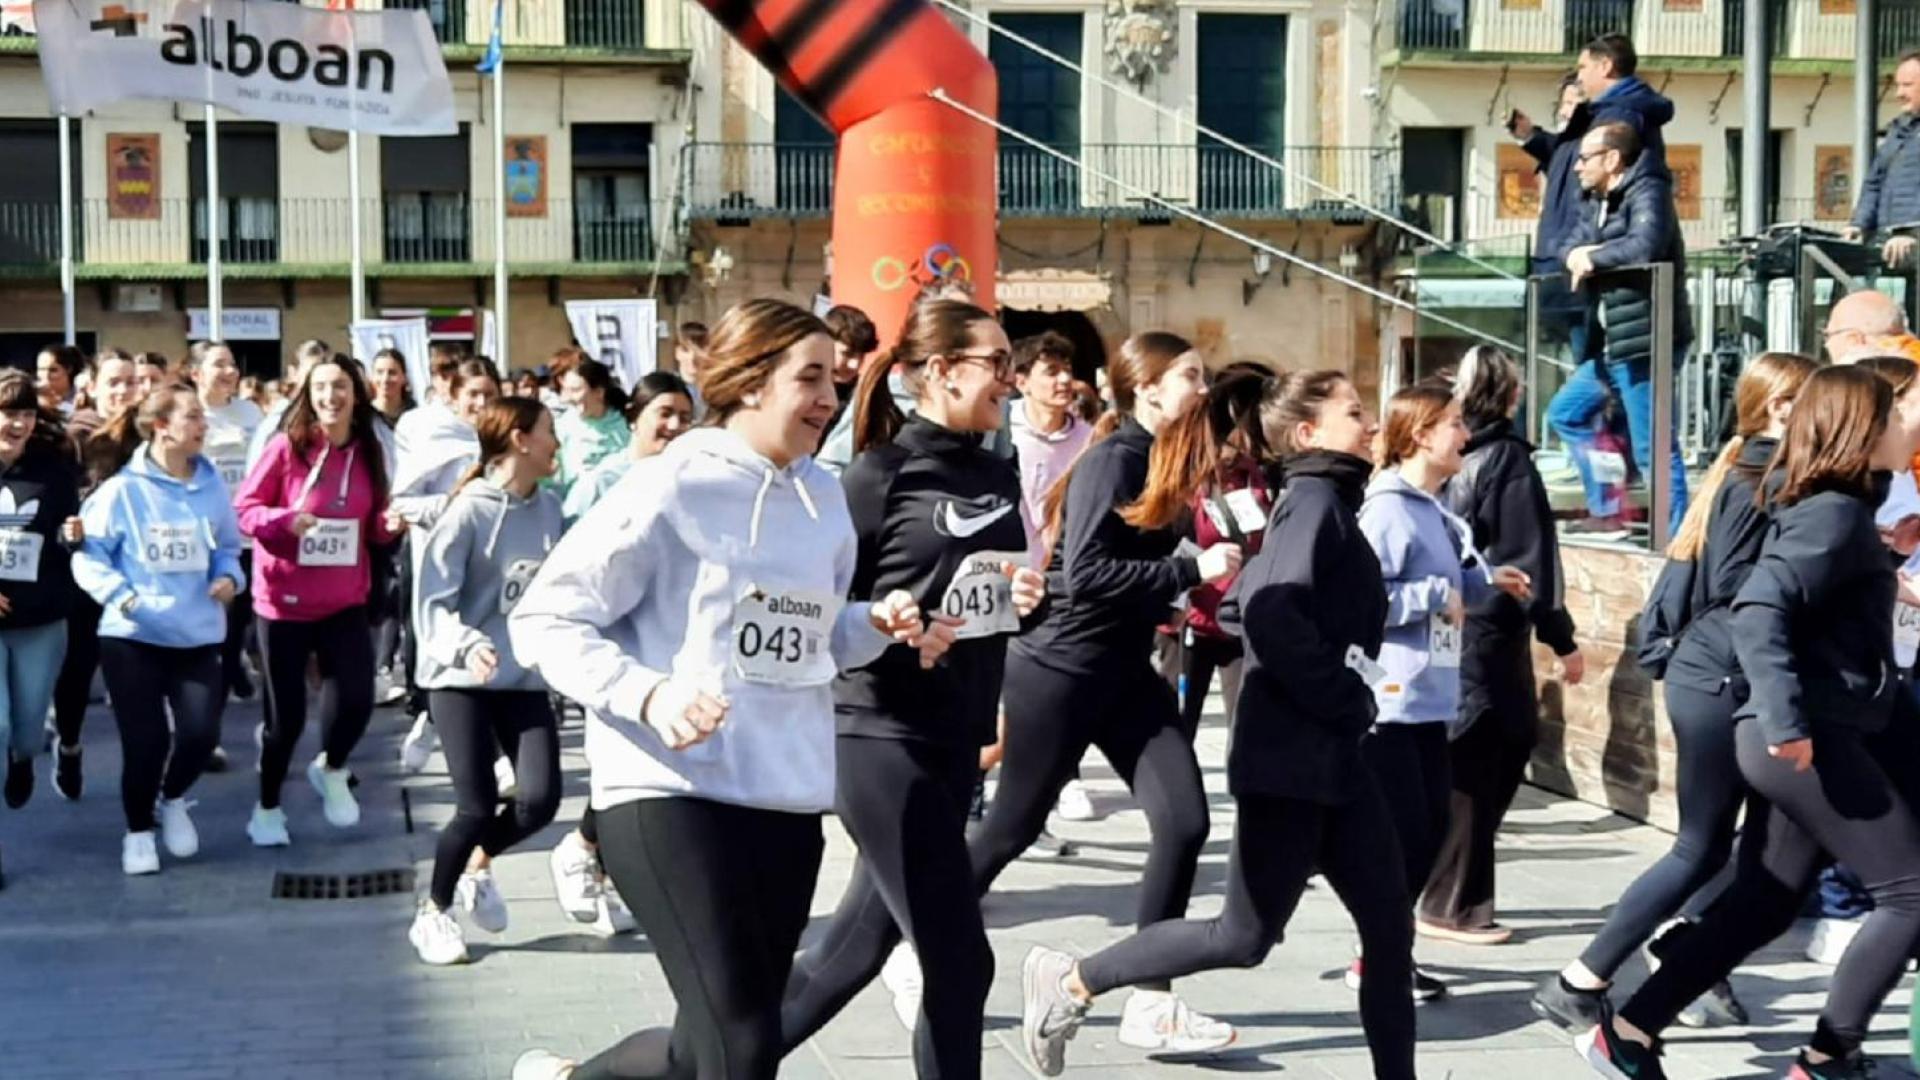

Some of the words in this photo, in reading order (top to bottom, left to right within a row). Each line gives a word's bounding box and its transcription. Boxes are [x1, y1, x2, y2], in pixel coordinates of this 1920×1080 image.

[160, 16, 395, 94] alboan
[147, 541, 188, 562] 043
[303, 537, 338, 555] 043
[768, 595, 823, 620] alboan
[946, 583, 994, 618] 043
[739, 621, 802, 663] 043
